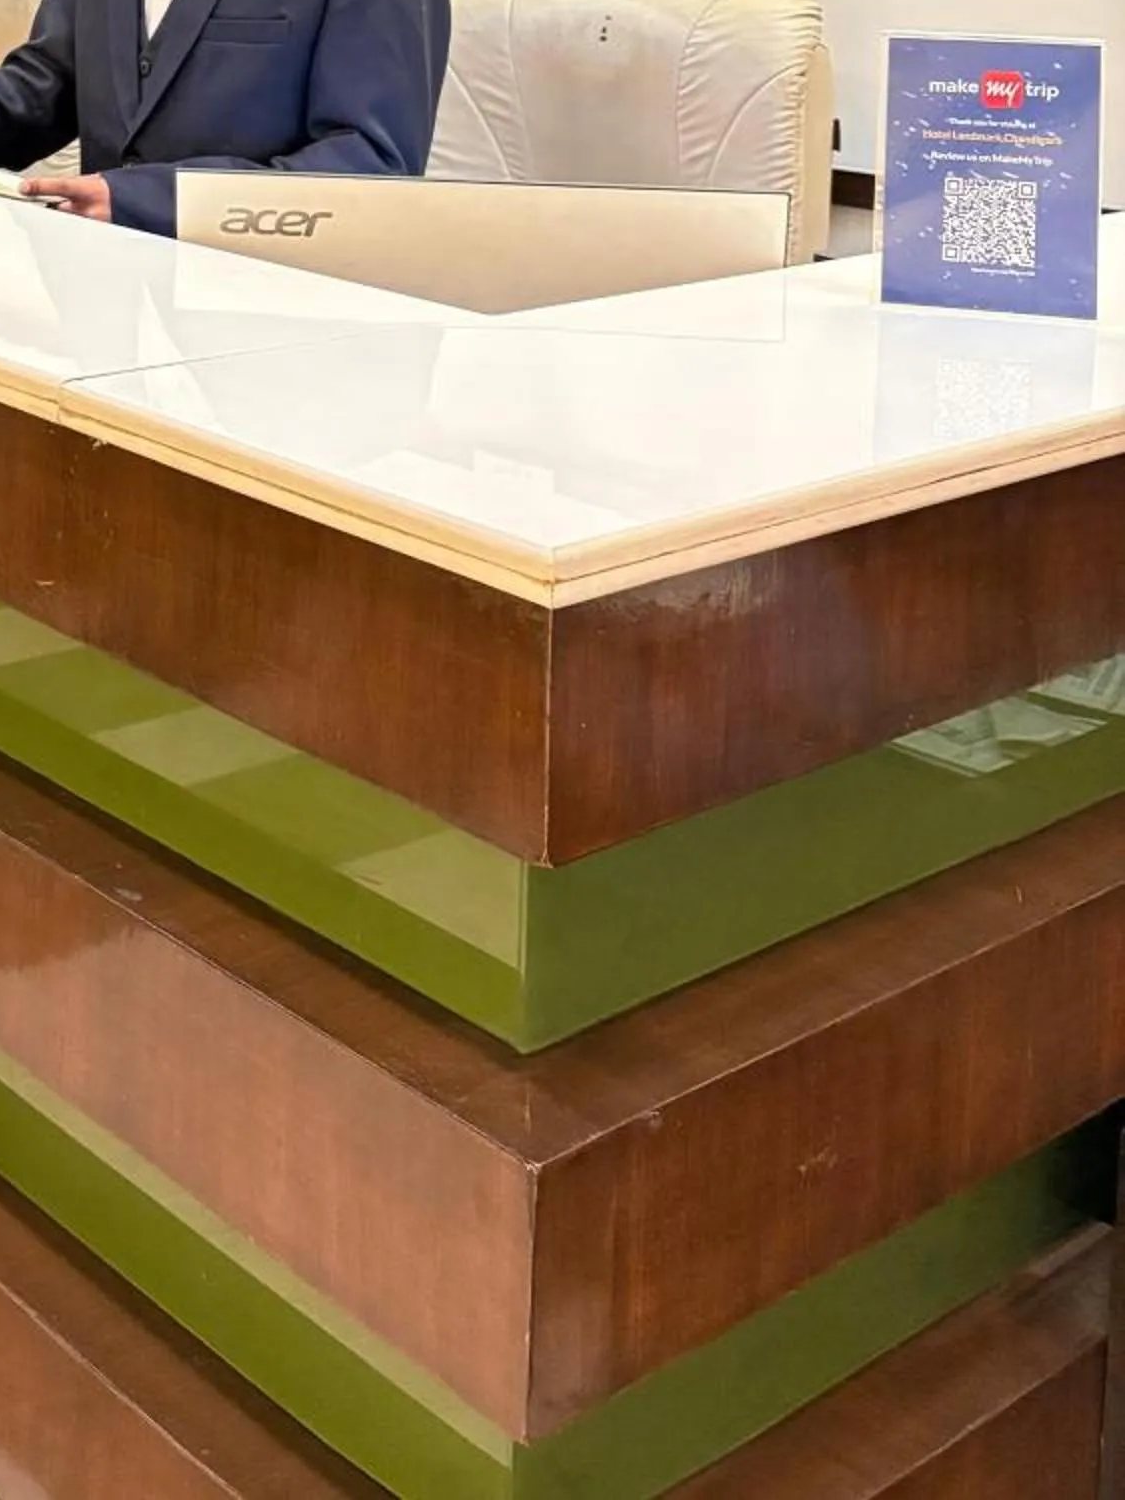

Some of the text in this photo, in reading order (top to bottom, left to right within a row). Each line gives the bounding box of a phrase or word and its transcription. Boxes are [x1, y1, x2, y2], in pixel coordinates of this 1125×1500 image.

[928, 78, 1060, 108] make my trip
[220, 207, 333, 237] acer
